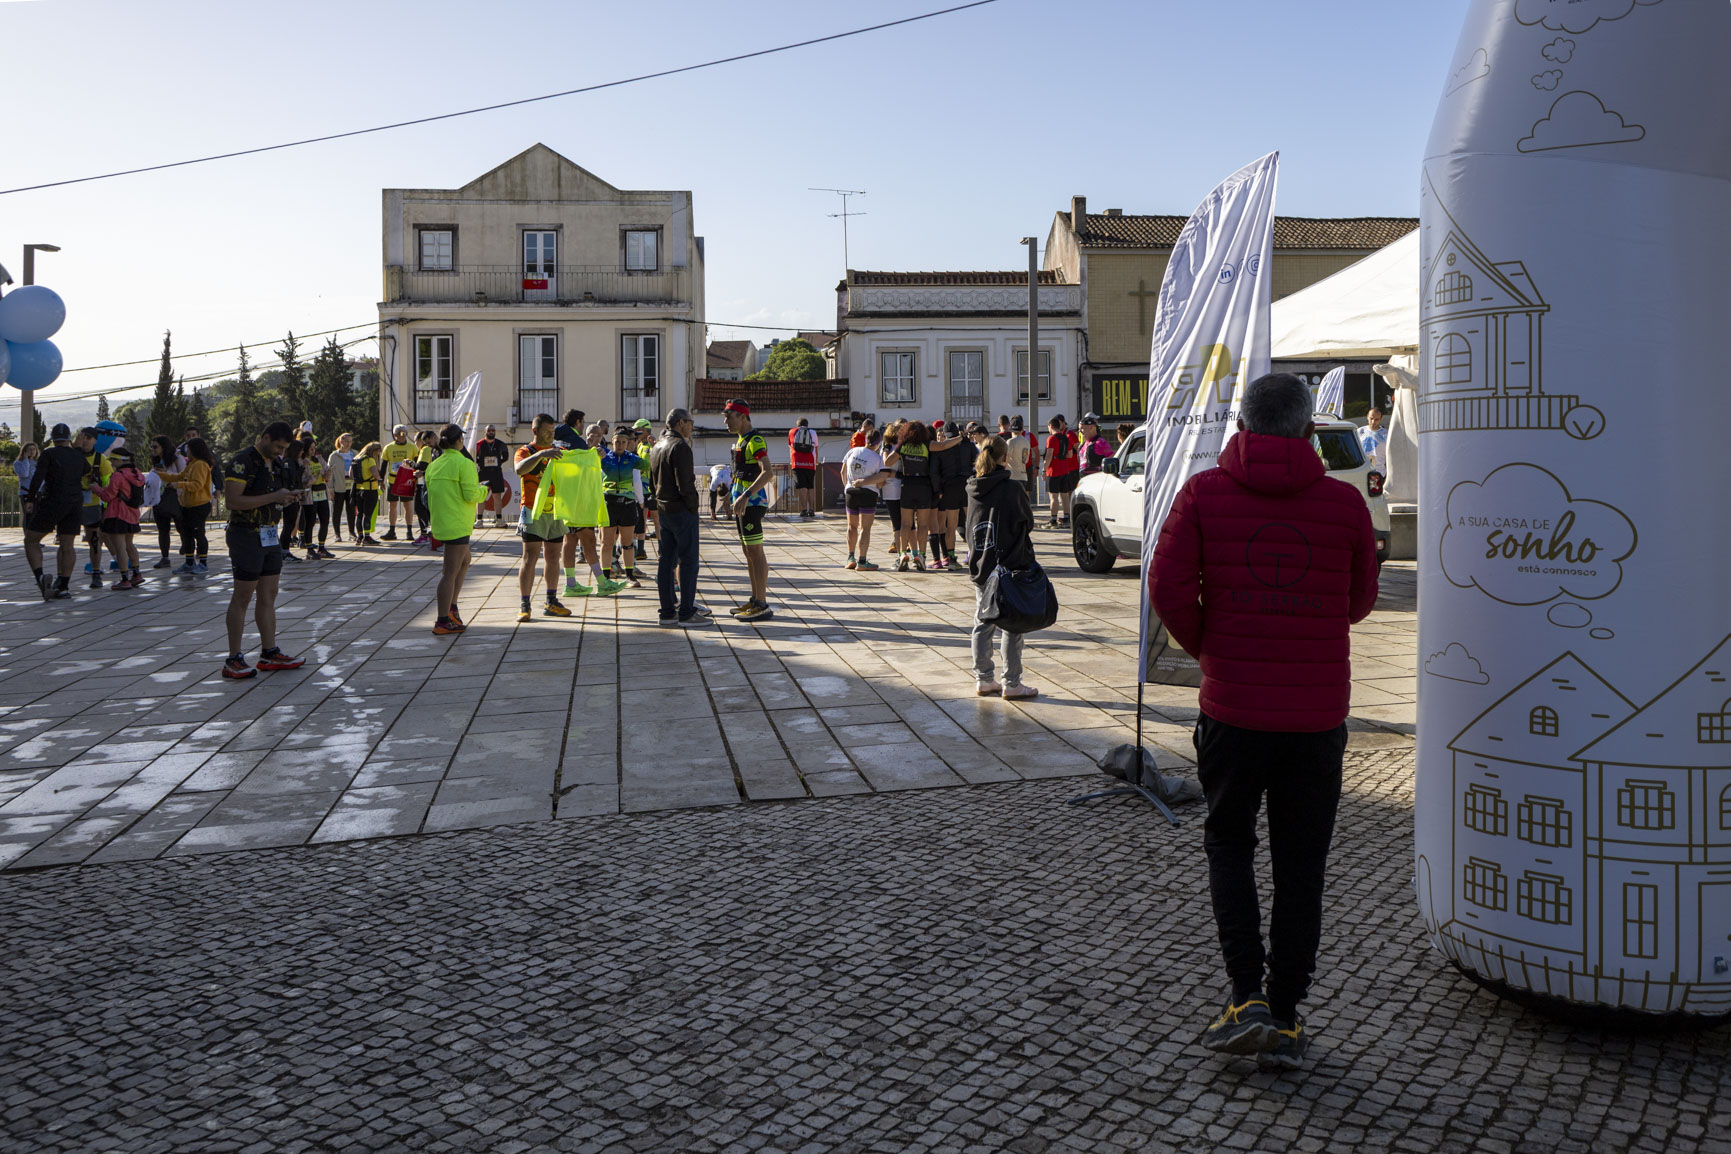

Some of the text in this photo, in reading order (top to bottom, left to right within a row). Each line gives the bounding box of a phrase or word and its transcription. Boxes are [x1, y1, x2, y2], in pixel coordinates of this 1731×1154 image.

[1102, 379, 1148, 416] BEM-V
[1189, 451, 1220, 460] www.r
[1459, 516, 1551, 530] A SUA CASA DE
[1485, 510, 1604, 563] sonho
[1517, 565, 1598, 577] está connosco
